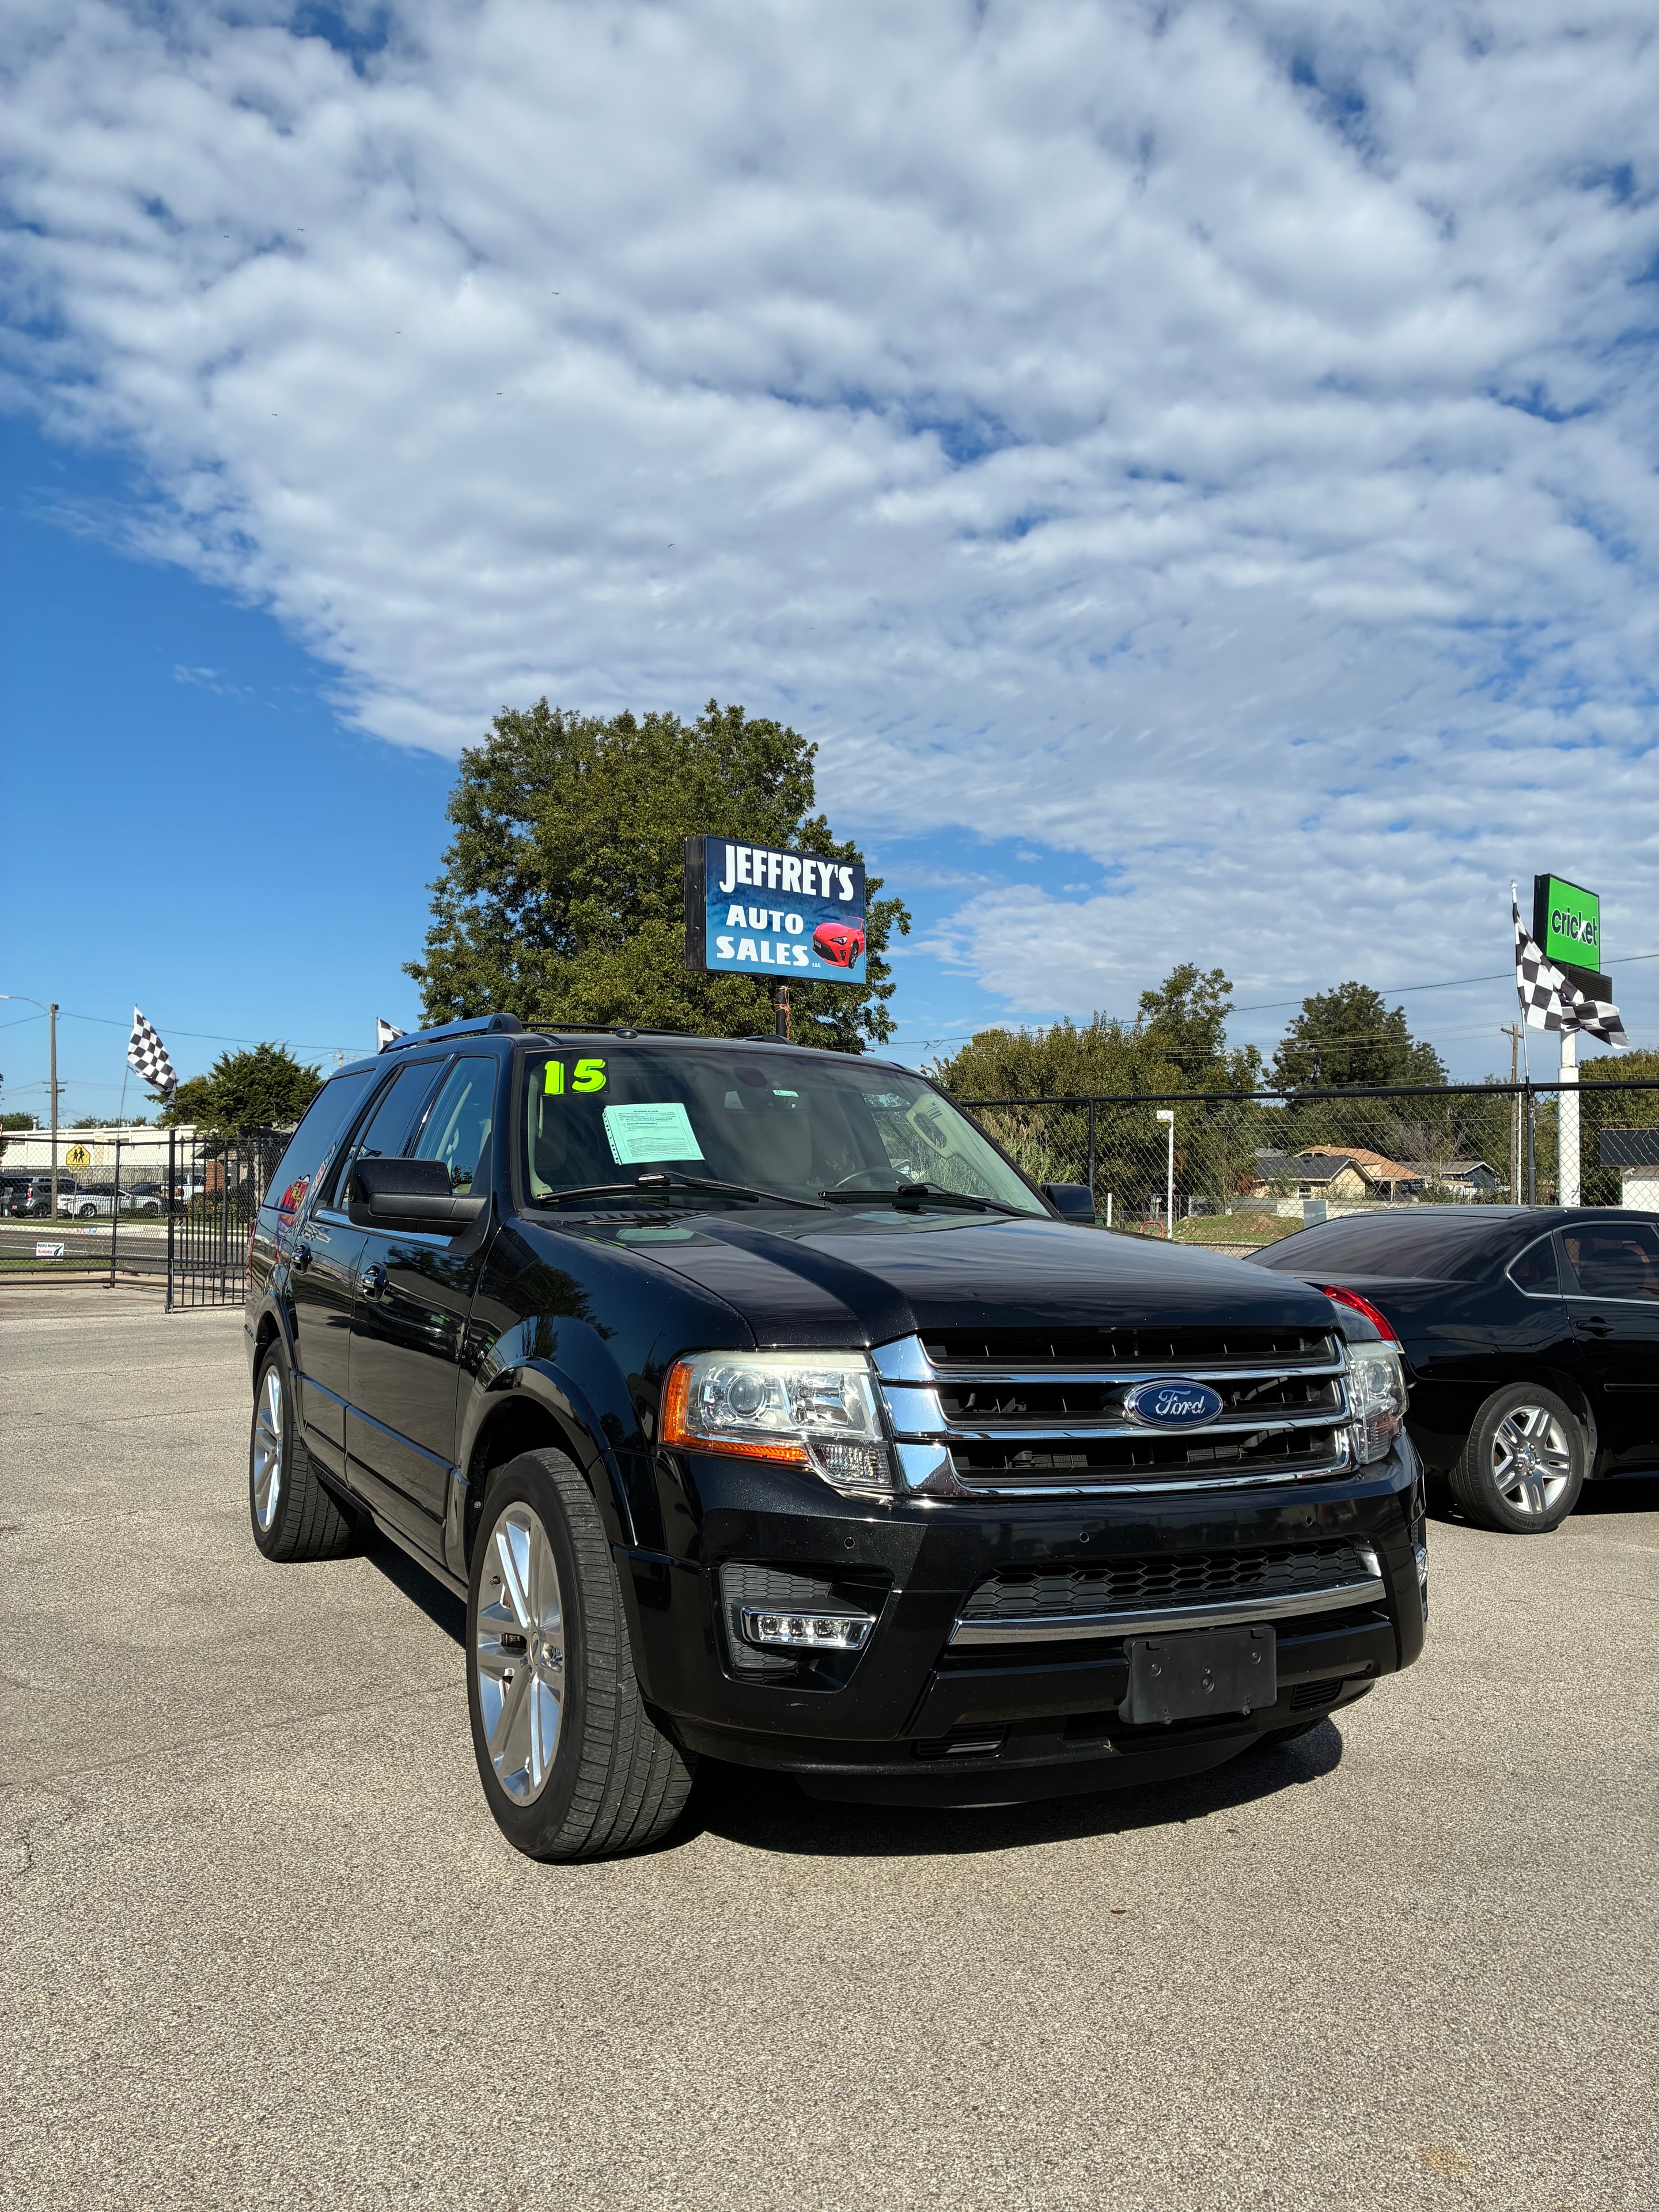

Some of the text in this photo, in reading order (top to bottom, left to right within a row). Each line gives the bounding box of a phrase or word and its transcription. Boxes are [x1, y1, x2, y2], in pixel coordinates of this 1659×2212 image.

[719, 844, 854, 902] JEFFREY'S
[726, 904, 804, 935] AUTO
[1551, 906, 1597, 947] cricket
[716, 935, 809, 967] SALES
[544, 1059, 607, 1095] 15
[1155, 1389, 1205, 1415] Ford
